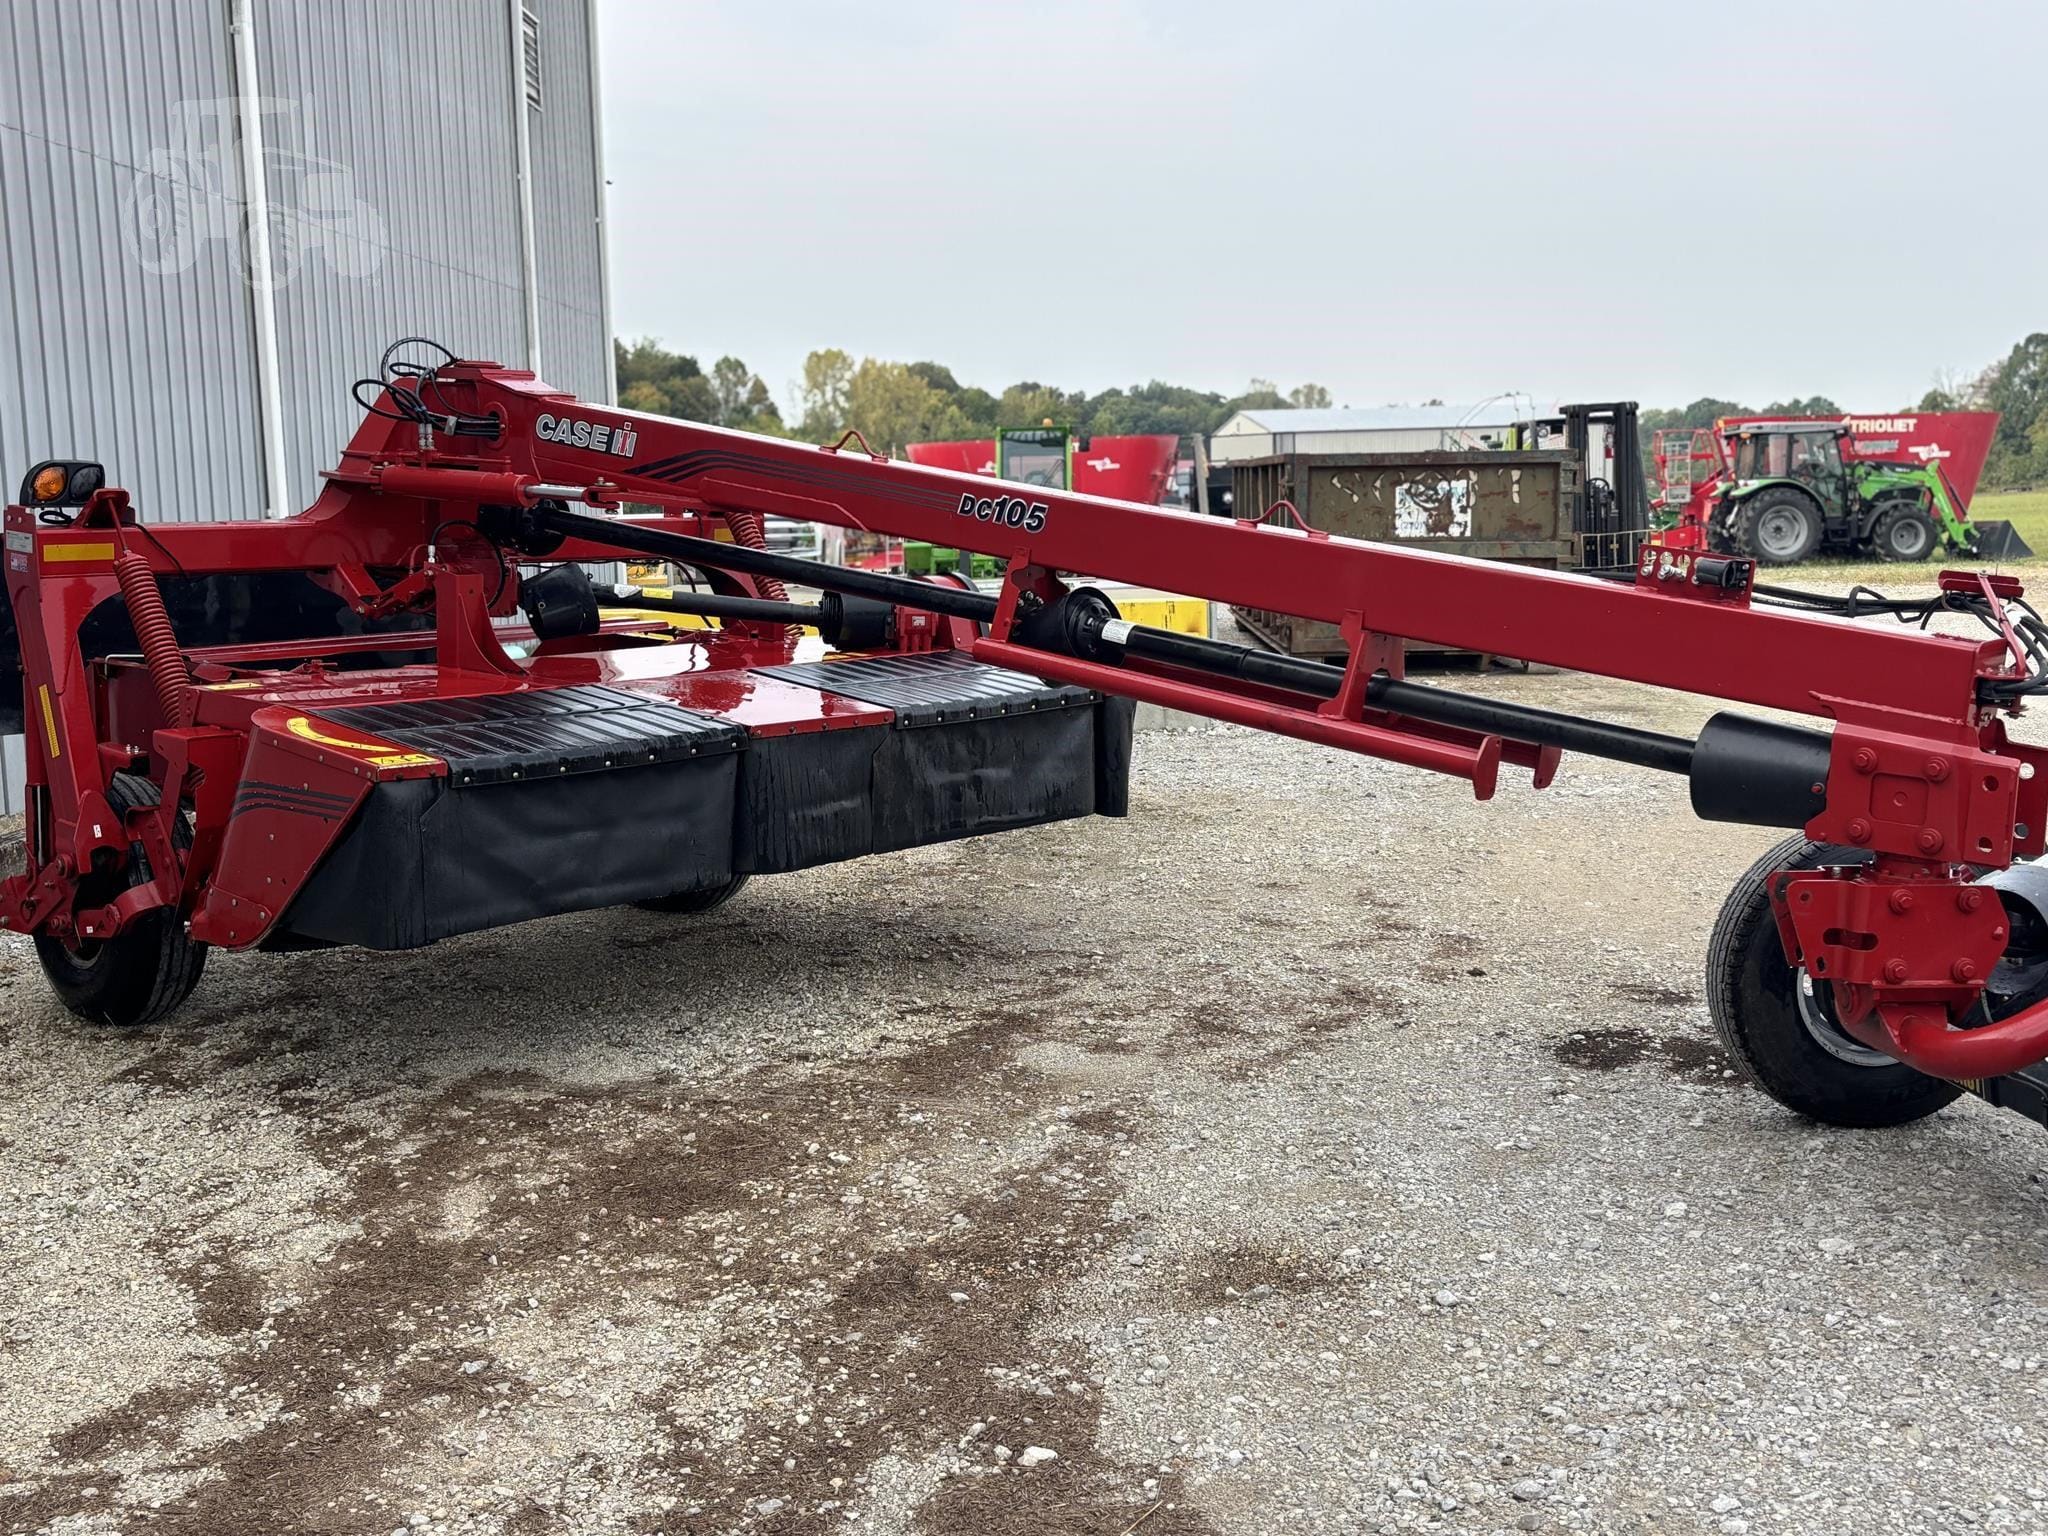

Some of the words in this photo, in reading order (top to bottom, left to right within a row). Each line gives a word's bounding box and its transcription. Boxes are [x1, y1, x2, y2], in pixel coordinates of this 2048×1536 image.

[535, 413, 611, 452] CASE
[1850, 418, 1918, 432] TRIOLIET
[957, 492, 1049, 534] DC105
